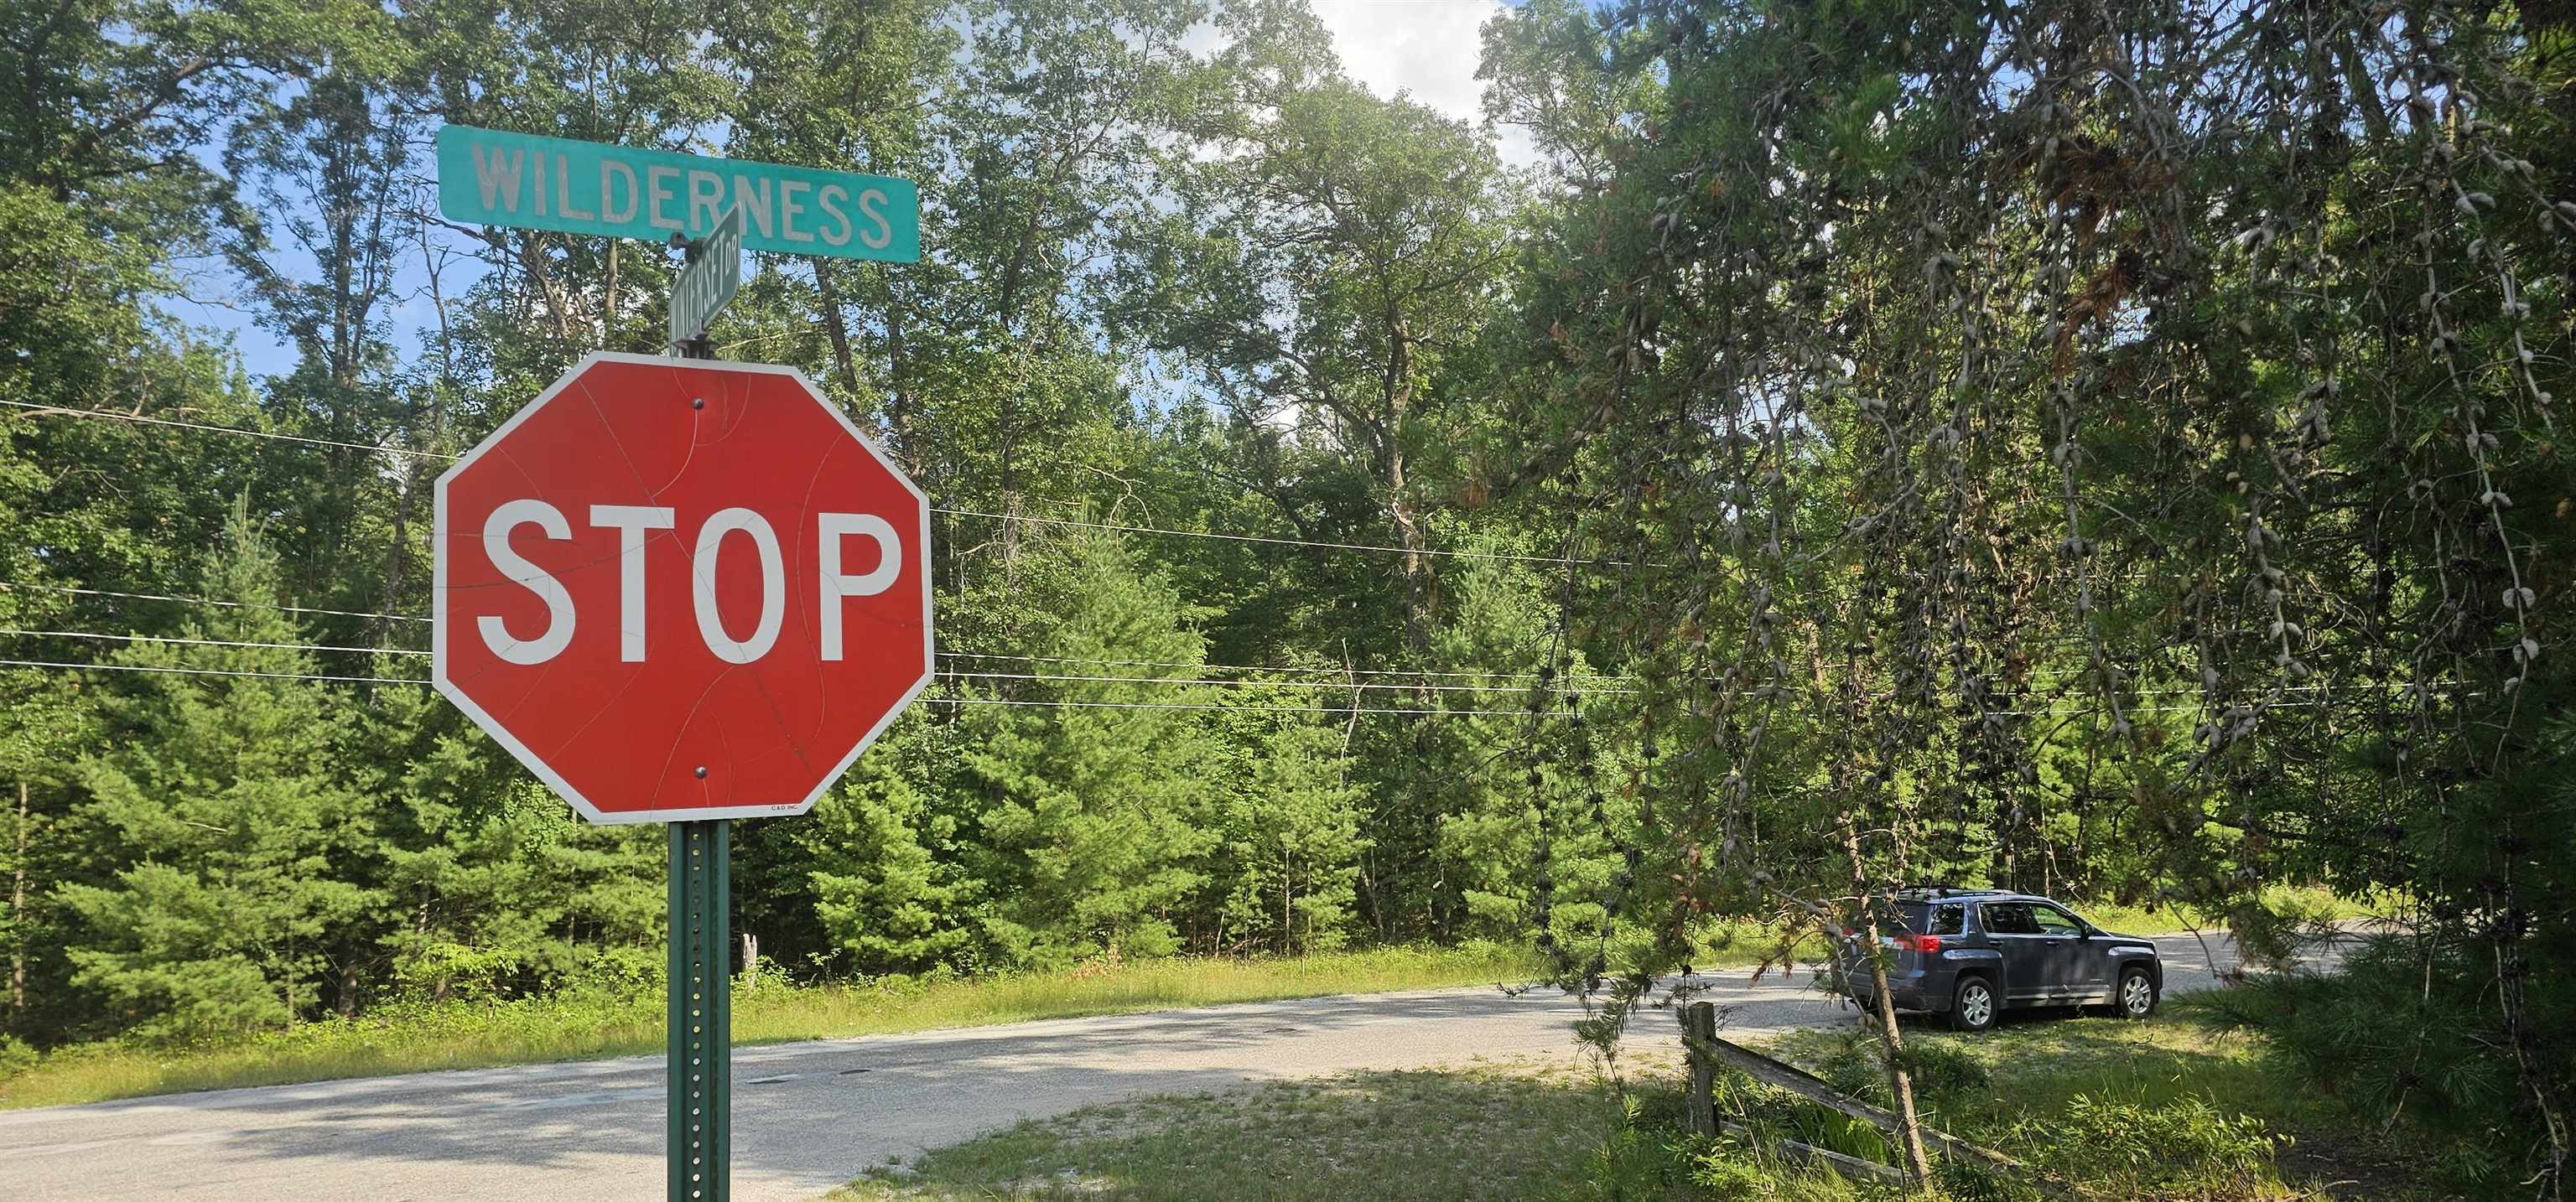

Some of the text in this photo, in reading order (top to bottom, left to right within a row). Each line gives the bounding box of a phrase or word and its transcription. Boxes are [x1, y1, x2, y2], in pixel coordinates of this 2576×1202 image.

[472, 143, 891, 249] WILDERNESS
[725, 234, 737, 276] DR
[477, 499, 902, 665] STOP
